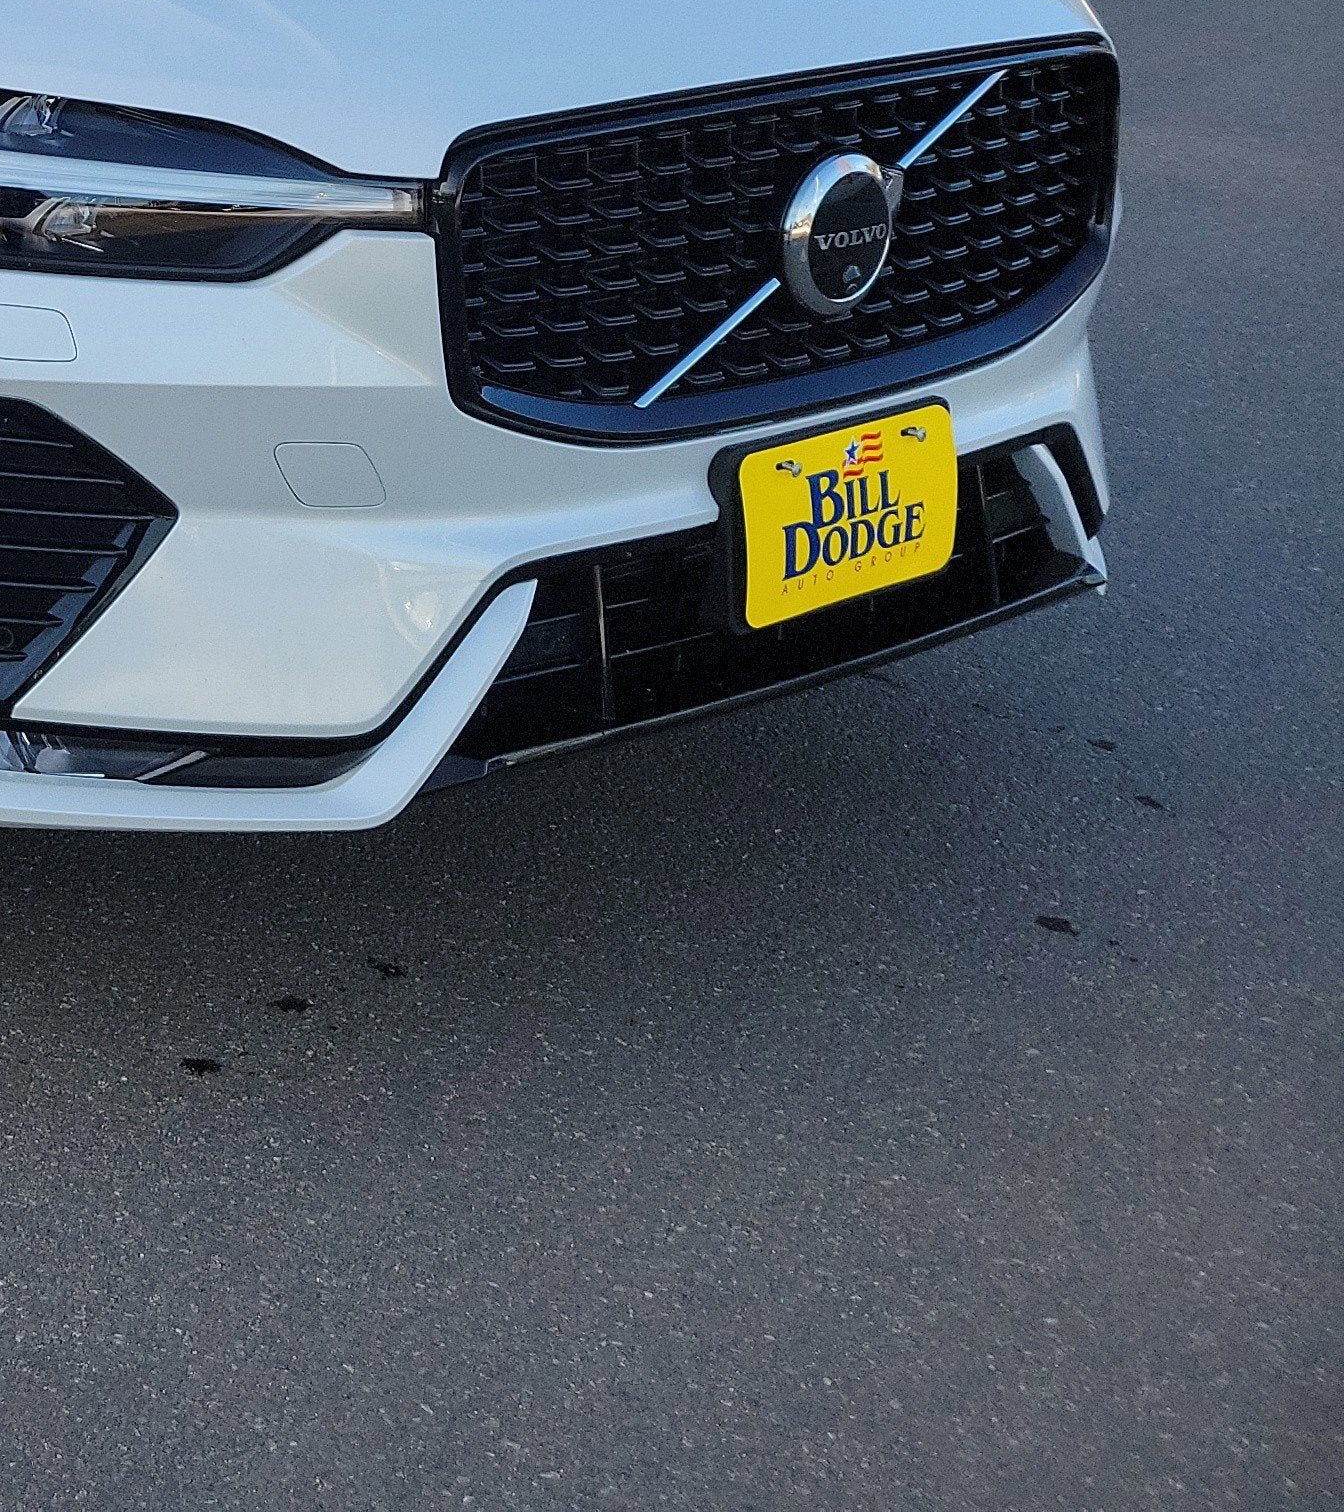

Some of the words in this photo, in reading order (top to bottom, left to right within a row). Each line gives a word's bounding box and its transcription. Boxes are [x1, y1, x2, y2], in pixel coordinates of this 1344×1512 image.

[814, 223, 887, 251] VOLVO
[805, 469, 901, 529] BILL
[781, 501, 926, 581] DODGE
[781, 569, 835, 596] AUTO
[854, 542, 921, 573] GROUP
